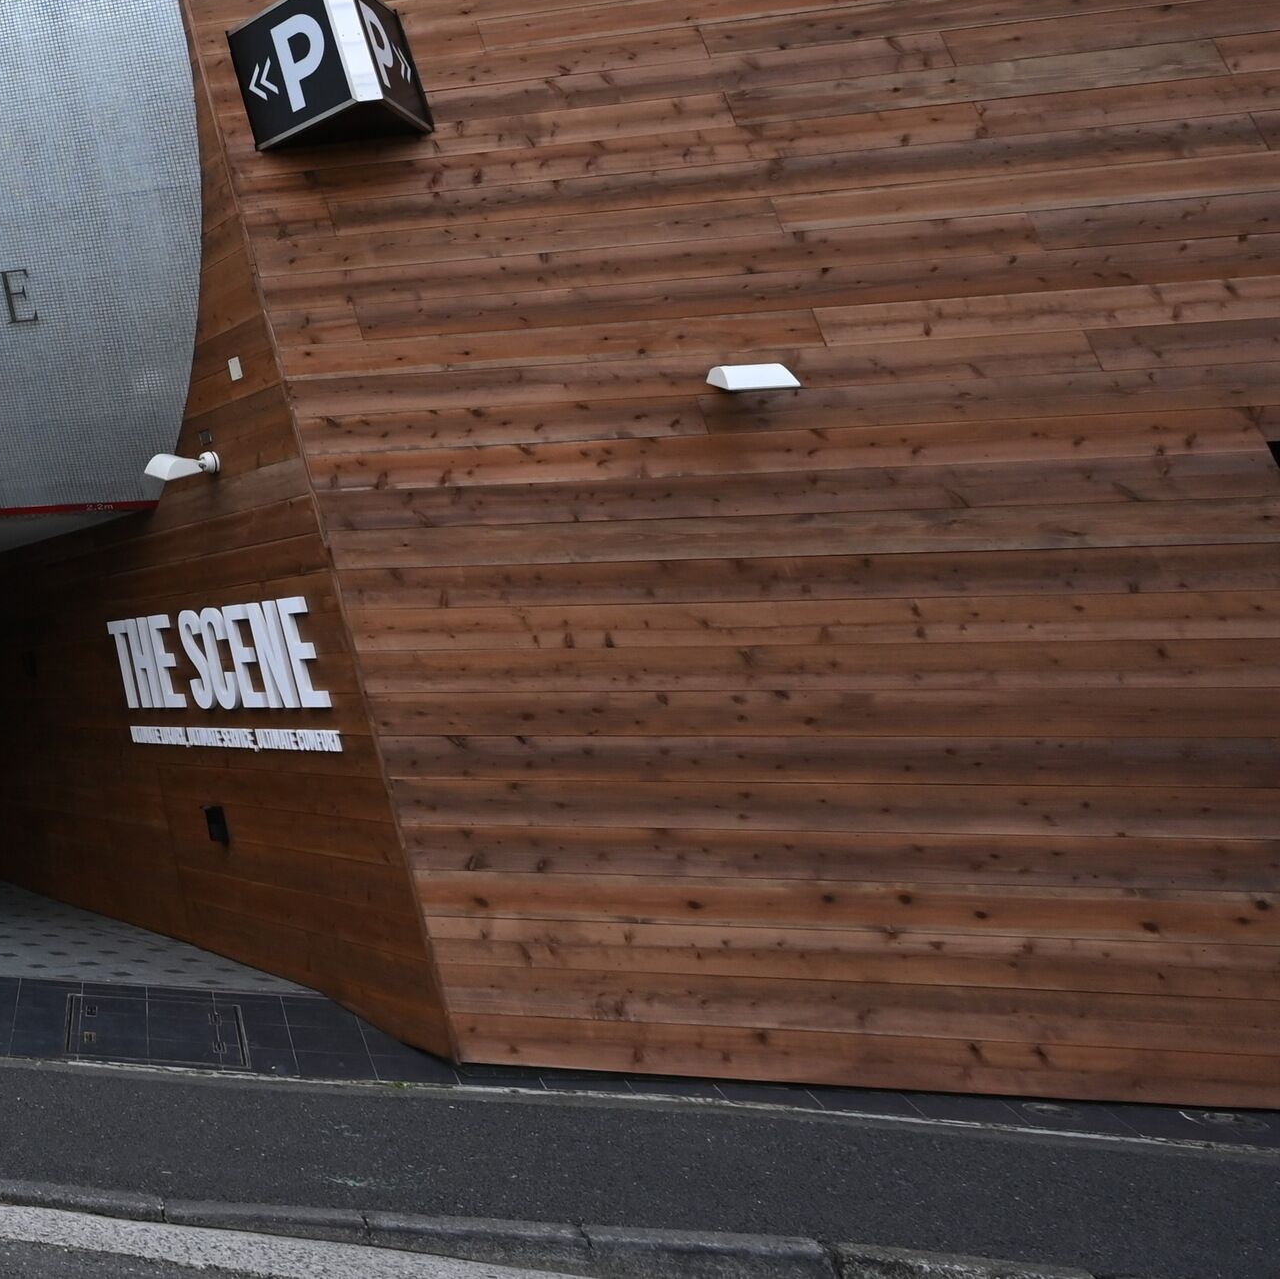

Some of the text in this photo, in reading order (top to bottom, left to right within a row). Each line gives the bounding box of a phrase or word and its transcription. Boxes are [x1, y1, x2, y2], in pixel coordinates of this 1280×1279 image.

[270, 13, 325, 113] P
[358, 0, 393, 89] P
[107, 596, 332, 710] THE SCENE
